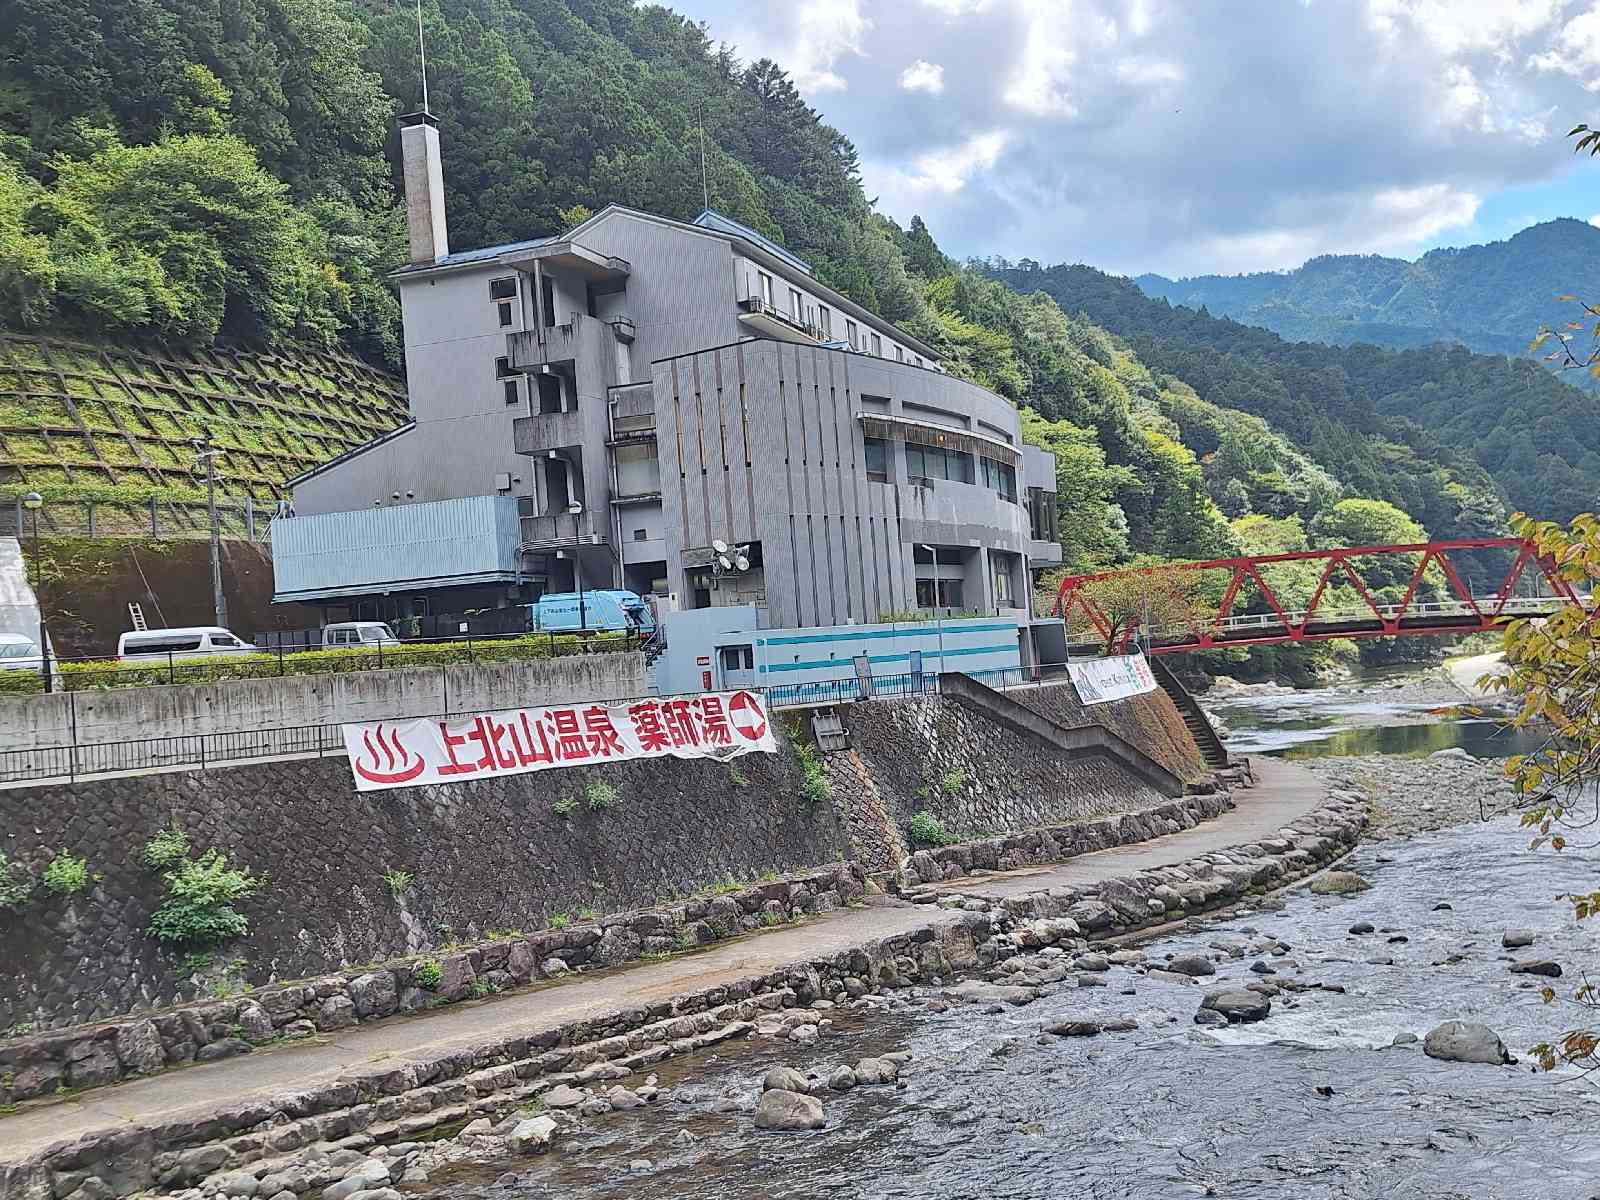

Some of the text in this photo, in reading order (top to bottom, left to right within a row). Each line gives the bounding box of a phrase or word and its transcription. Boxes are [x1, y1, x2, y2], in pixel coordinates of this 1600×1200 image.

[438, 697, 732, 776] 上北山温泉 薬師湯
